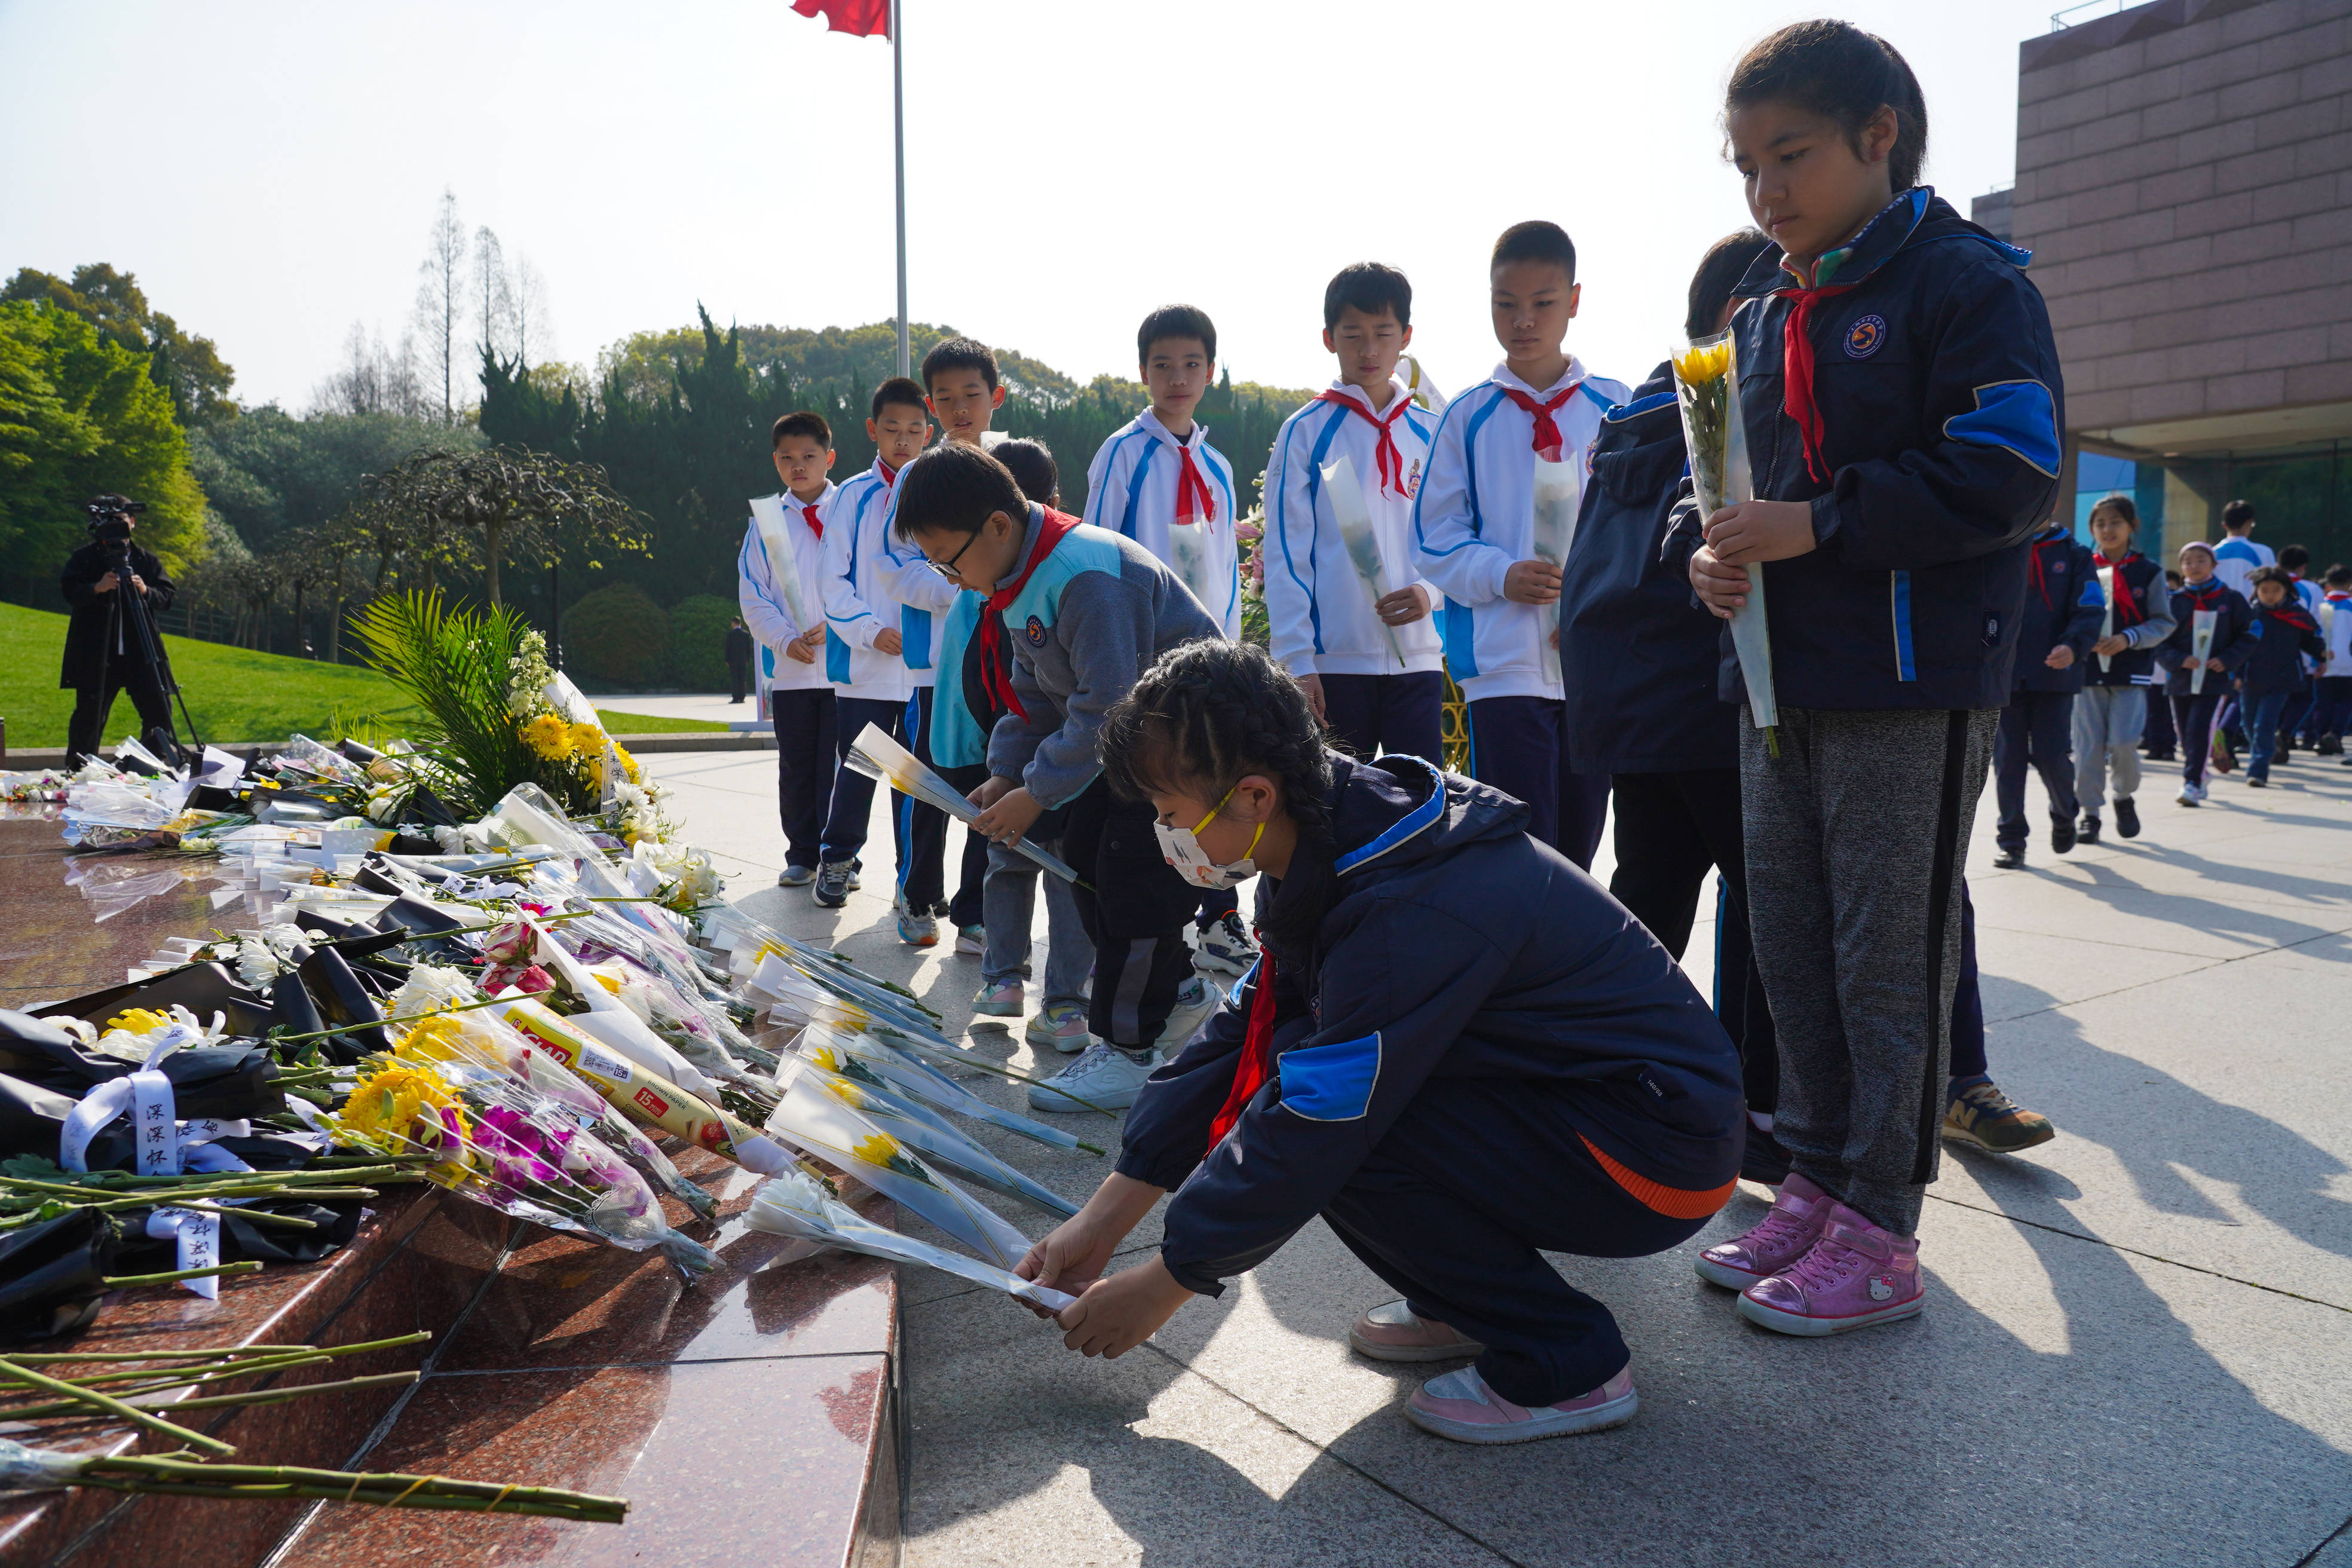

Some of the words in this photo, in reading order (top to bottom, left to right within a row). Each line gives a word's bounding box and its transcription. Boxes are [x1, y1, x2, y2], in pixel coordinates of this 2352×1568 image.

[638, 1091, 654, 1106] 15
[647, 1080, 669, 1097] BROWN
[668, 1095, 687, 1110] PAPER
[1646, 1079, 1663, 1097] 140/68
[146, 1103, 167, 1176] 深深怀
